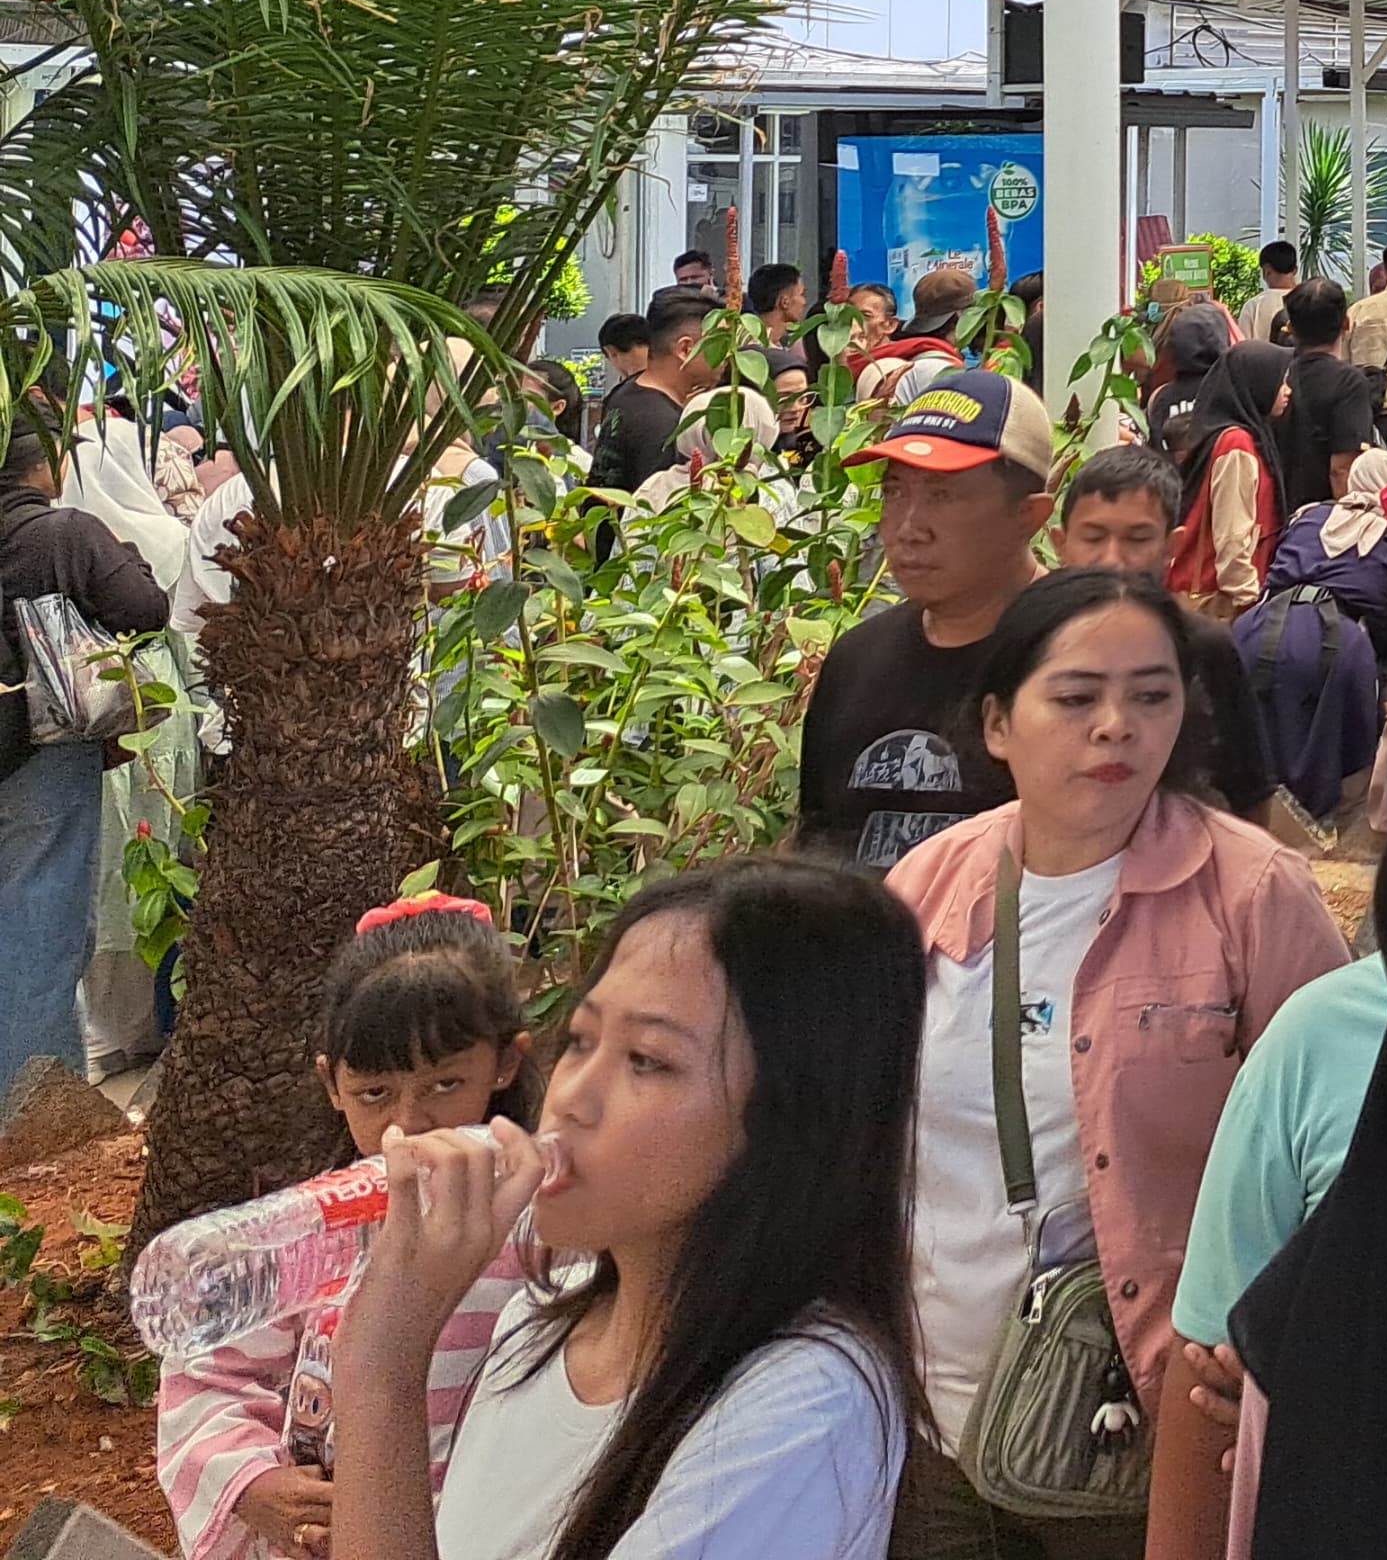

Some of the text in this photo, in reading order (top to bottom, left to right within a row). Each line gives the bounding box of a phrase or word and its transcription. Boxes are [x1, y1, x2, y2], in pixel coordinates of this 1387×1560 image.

[1002, 177, 1029, 187] 100%
[995, 188, 1035, 198] BEBAS
[1001, 199, 1028, 210] BPA
